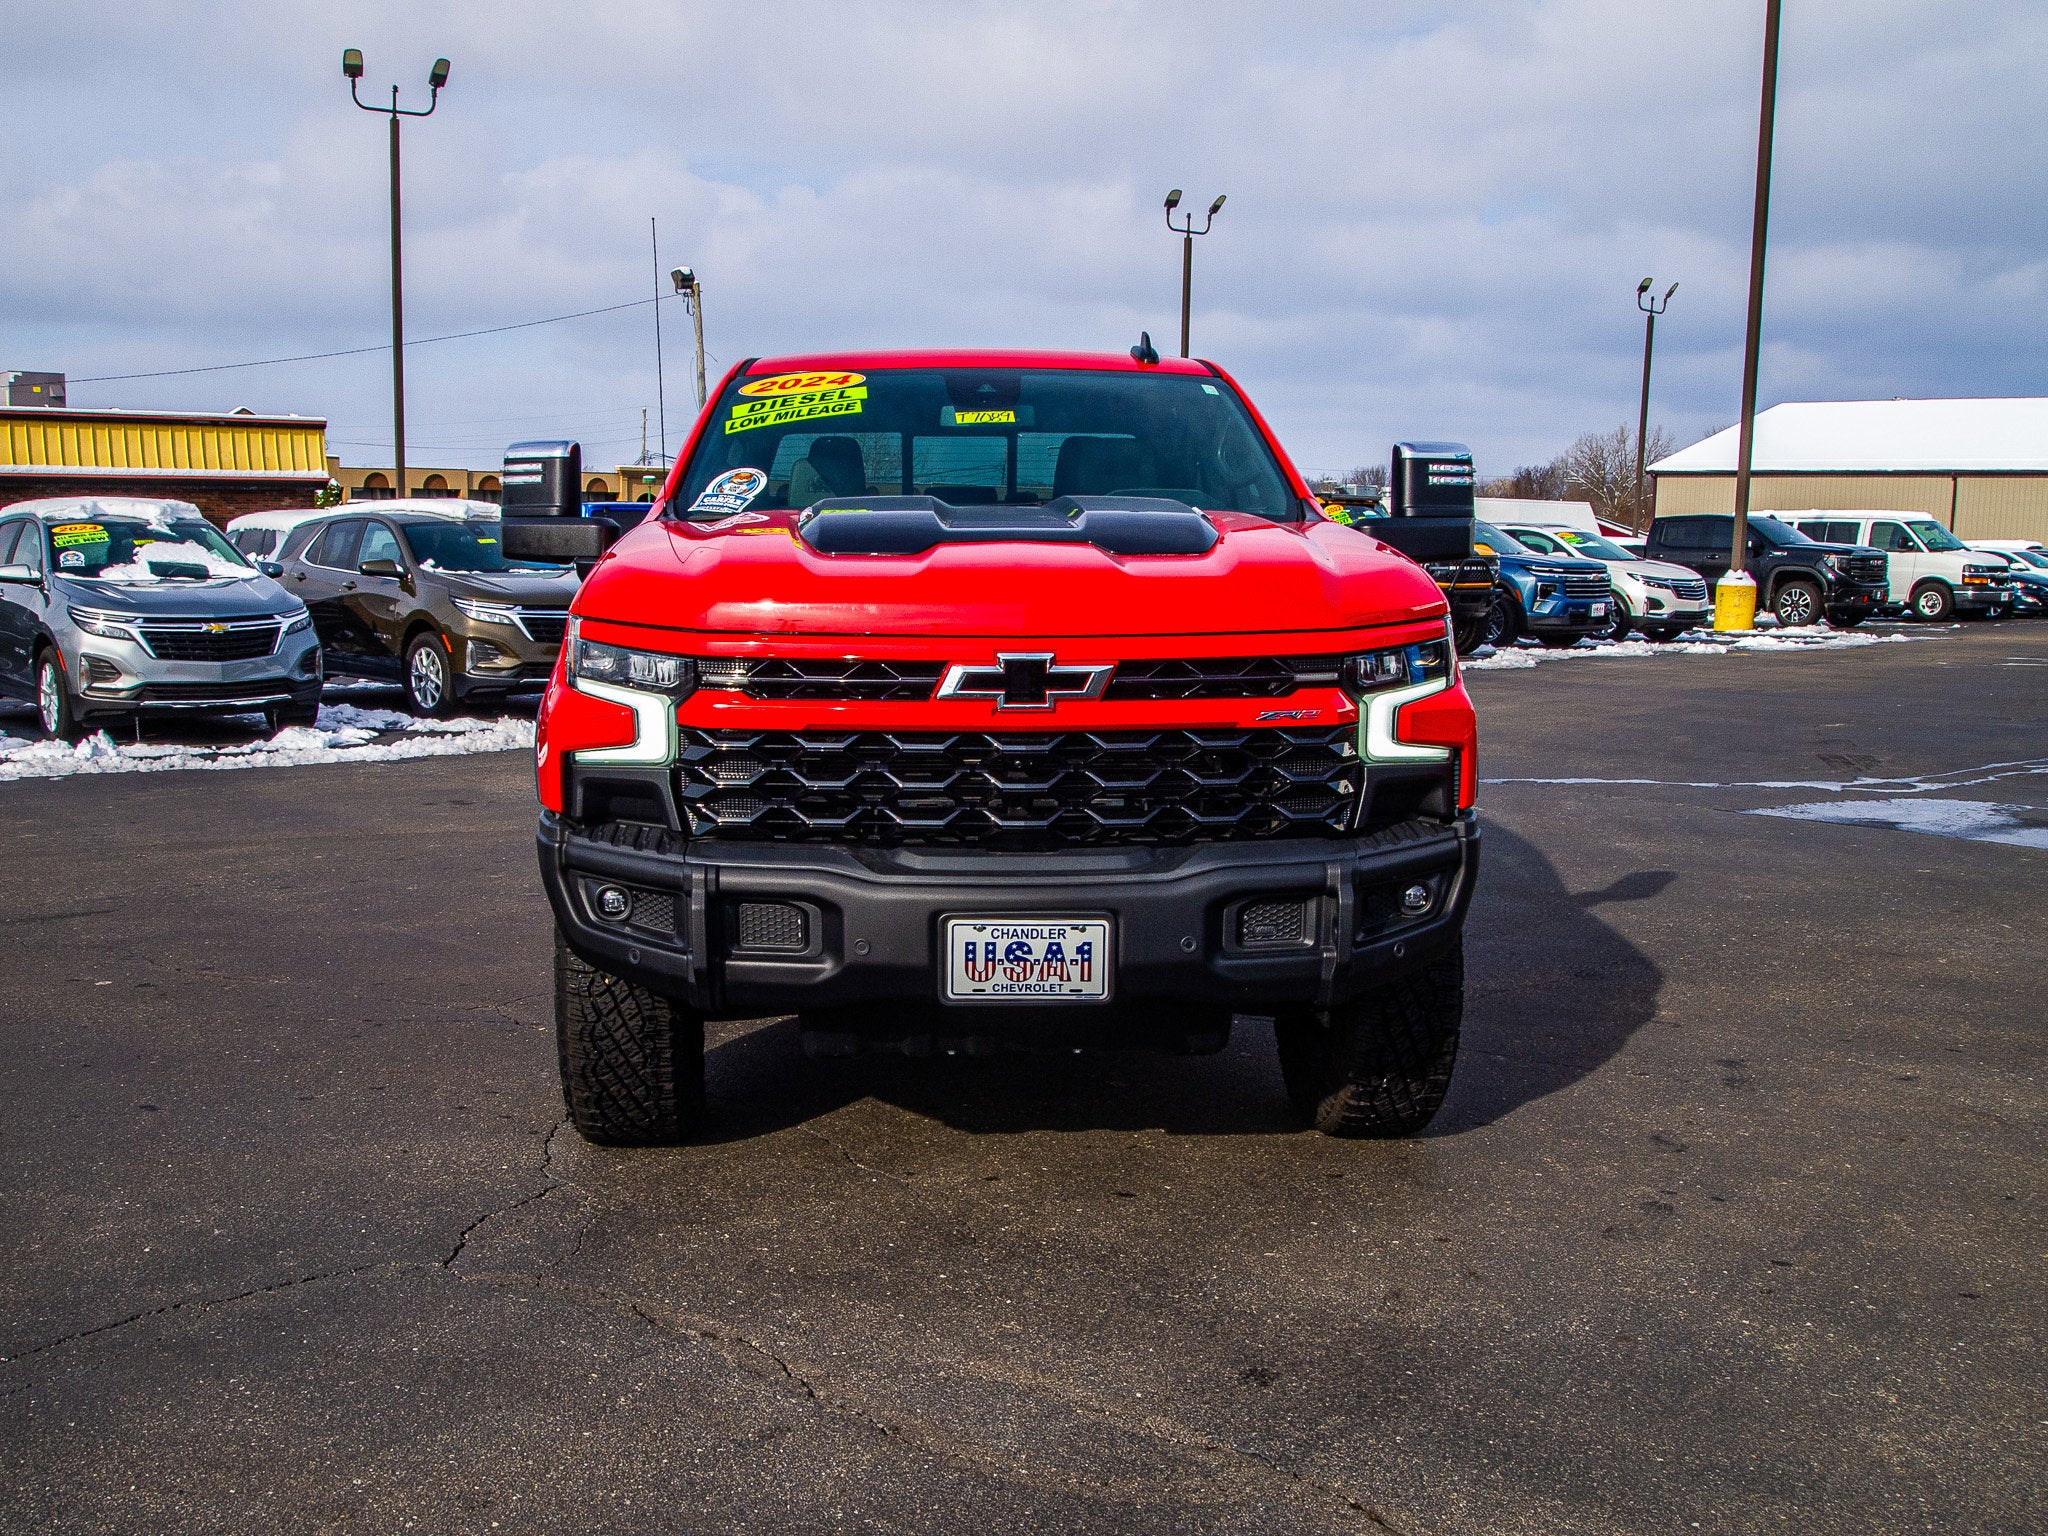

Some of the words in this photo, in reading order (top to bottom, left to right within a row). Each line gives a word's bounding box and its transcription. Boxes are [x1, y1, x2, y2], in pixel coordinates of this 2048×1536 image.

[751, 374, 854, 394] 2024
[747, 389, 852, 414] DIESEL
[728, 414, 771, 431] LOW
[774, 401, 857, 422] MILEAGE
[1255, 709, 1322, 721] ZR2
[990, 928, 1067, 940] CHANDLER
[992, 983, 1064, 993] CHEVROLET
